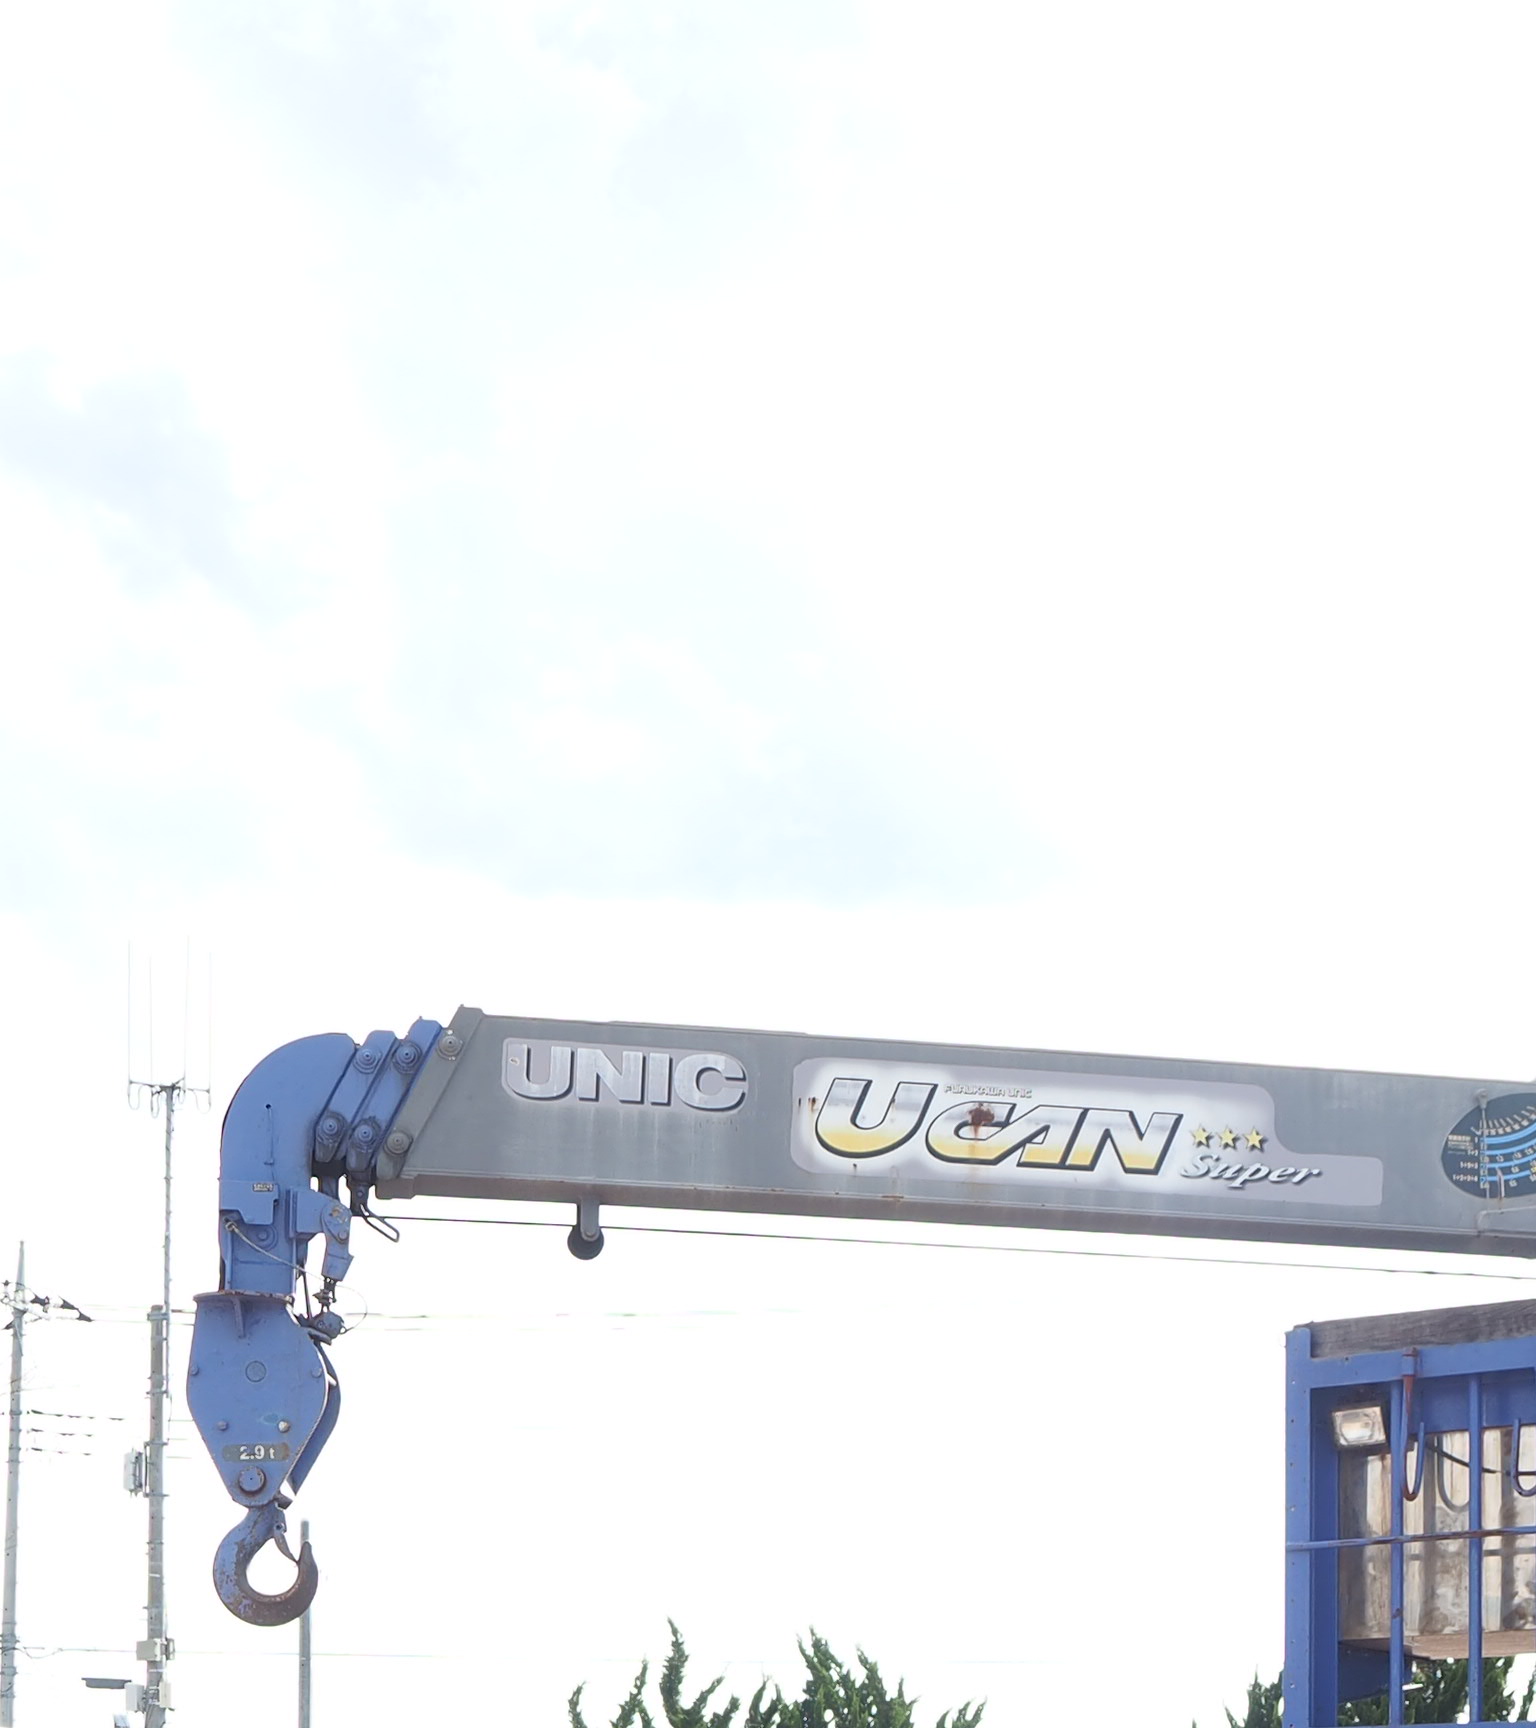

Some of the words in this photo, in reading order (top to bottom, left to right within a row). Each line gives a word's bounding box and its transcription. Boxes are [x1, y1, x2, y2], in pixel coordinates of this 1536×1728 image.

[506, 1043, 746, 1112] UNIC
[944, 1083, 1005, 1097] FURUKAWA
[1007, 1087, 1033, 1099] UNIC
[815, 1077, 1184, 1176] UCAN
[1180, 1153, 1322, 1190] Super
[239, 1445, 265, 1460] 2.9
